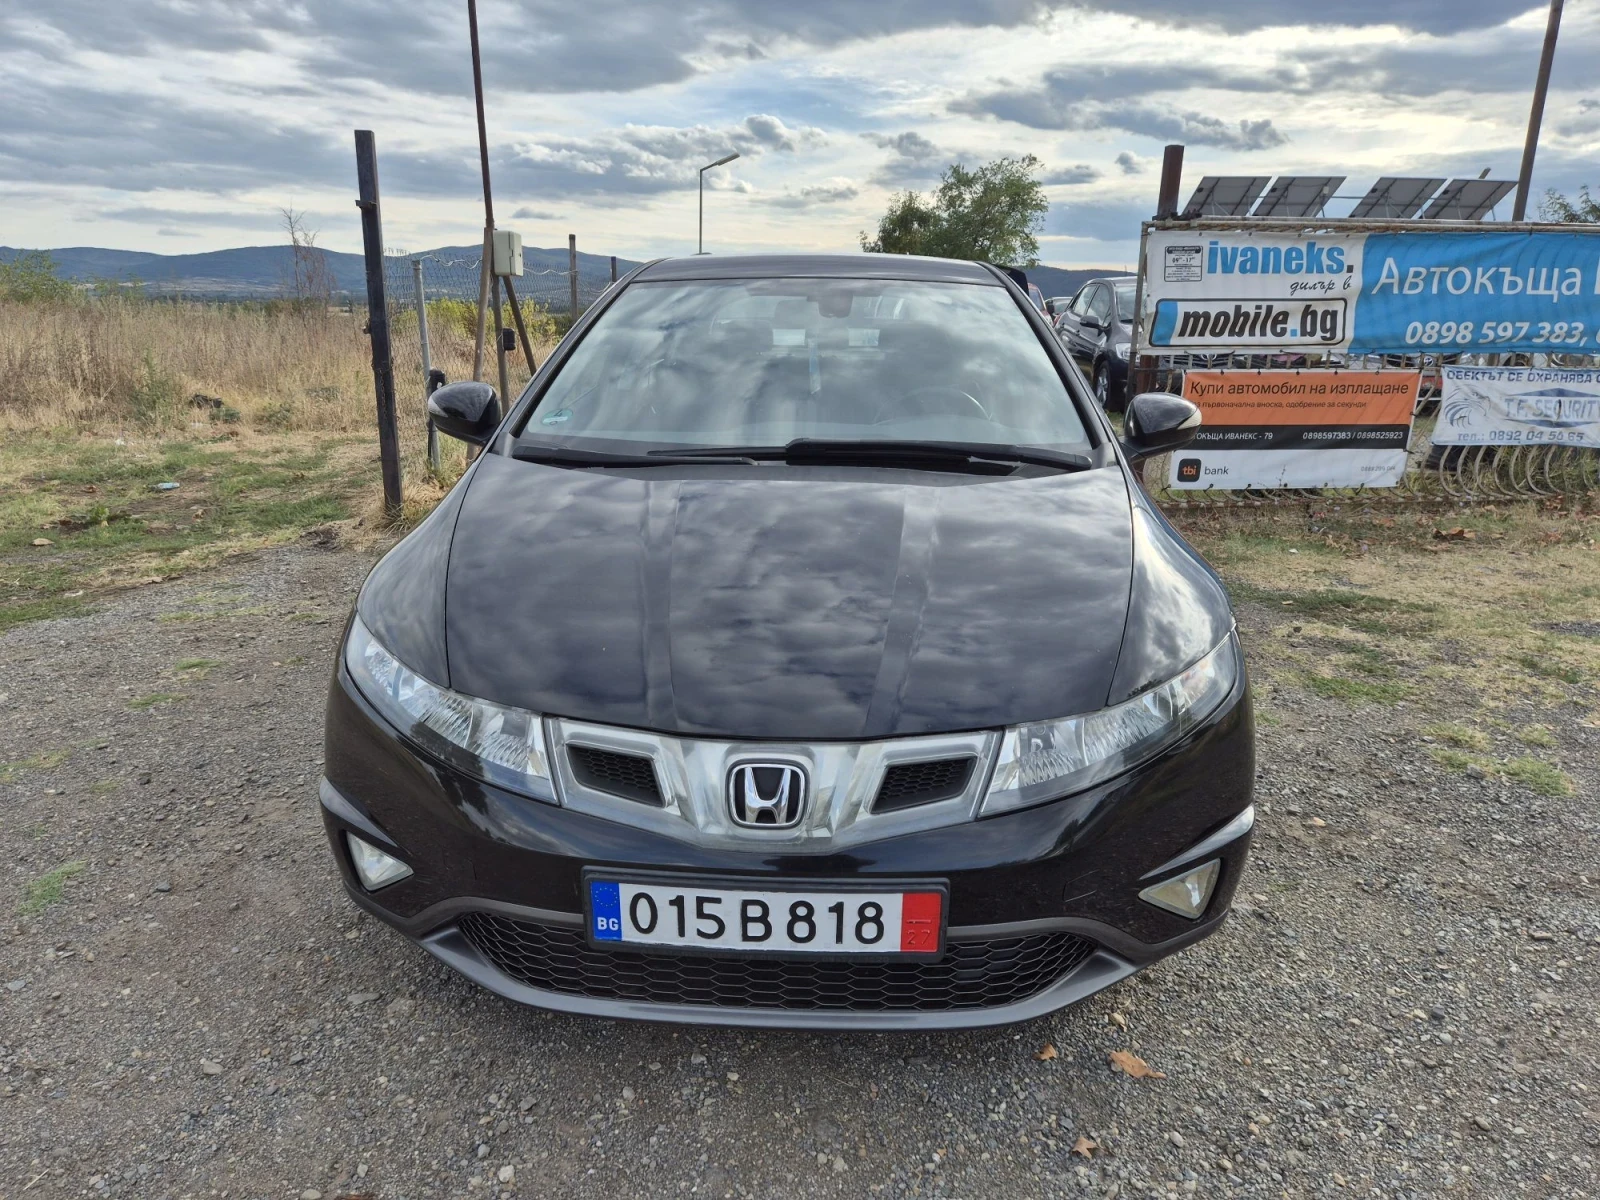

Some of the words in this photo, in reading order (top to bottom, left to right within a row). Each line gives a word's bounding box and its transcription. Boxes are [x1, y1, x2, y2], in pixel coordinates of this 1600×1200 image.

[1290, 279, 1336, 296] дилър
[1371, 257, 1582, 303] Автокъща
[1178, 304, 1339, 341] mobile.bg
[1405, 321, 1474, 344] 0898
[1478, 322, 1530, 344] 597
[1532, 322, 1588, 347] 383,
[1447, 370, 1504, 381] ОБЕКТЪТ
[1507, 372, 1523, 382] СЕ
[1527, 372, 1592, 383] ОХРАНЯВА
[1190, 381, 1224, 396] Купи
[1227, 381, 1306, 395] автомобил
[1309, 384, 1327, 394] на
[1330, 384, 1409, 395] изплащане
[1194, 432, 1223, 441] ОКЪЩА
[1225, 432, 1257, 440] ИВАНЕКС
[1264, 432, 1273, 440] 79
[1302, 431, 1351, 440] 0898597383
[1182, 465, 1197, 475] tbi
[1204, 465, 1229, 475] bank
[597, 916, 619, 931] BG
[629, 891, 884, 945] 015B818
